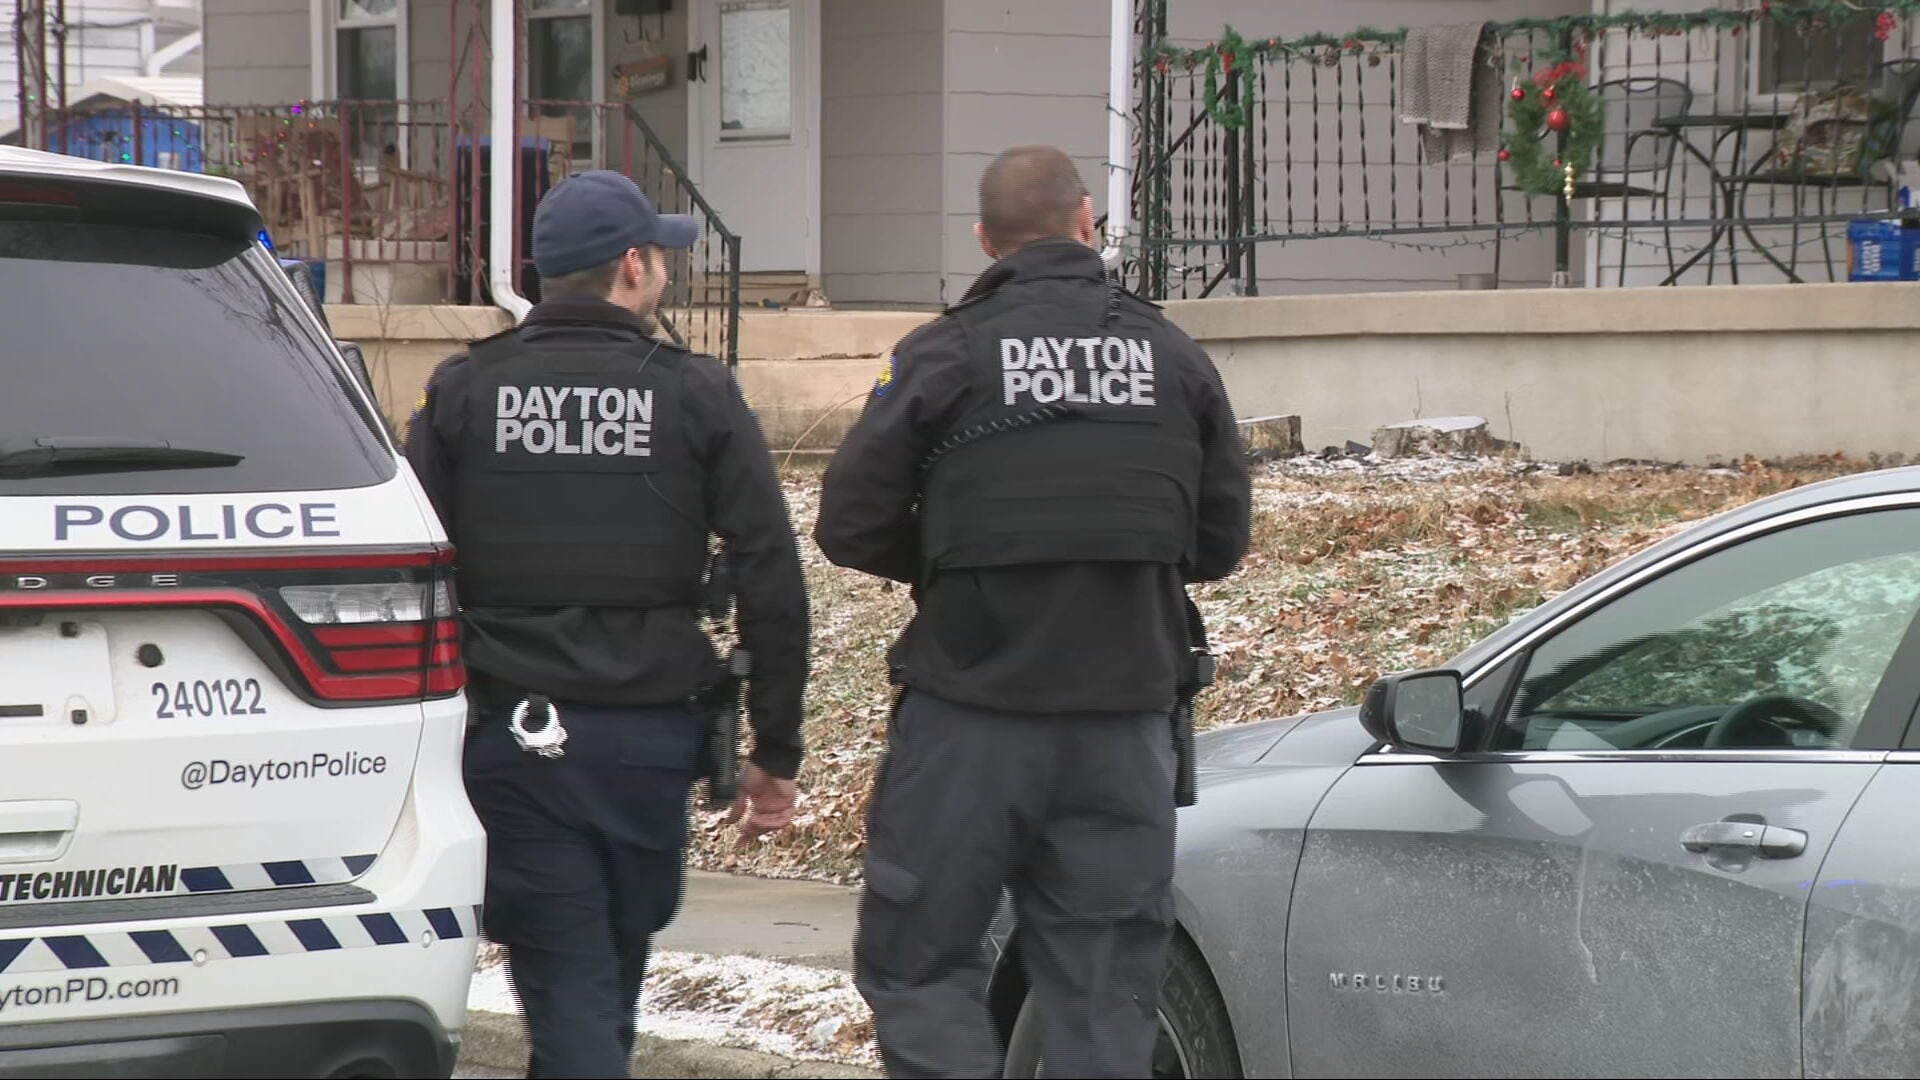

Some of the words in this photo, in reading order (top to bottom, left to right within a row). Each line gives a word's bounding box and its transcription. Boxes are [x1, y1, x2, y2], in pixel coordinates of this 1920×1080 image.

[1001, 336, 1155, 371] DAYTON
[496, 385, 654, 422] DAYTON
[1003, 369, 1156, 406] POLICE
[495, 419, 652, 457] POLICE
[54, 503, 341, 541] POLICE
[151, 678, 267, 719] 240122
[181, 751, 387, 791] @DaytonPolice
[0, 864, 177, 901] TECHNICIAN
[1329, 972, 1446, 994] MALIBU
